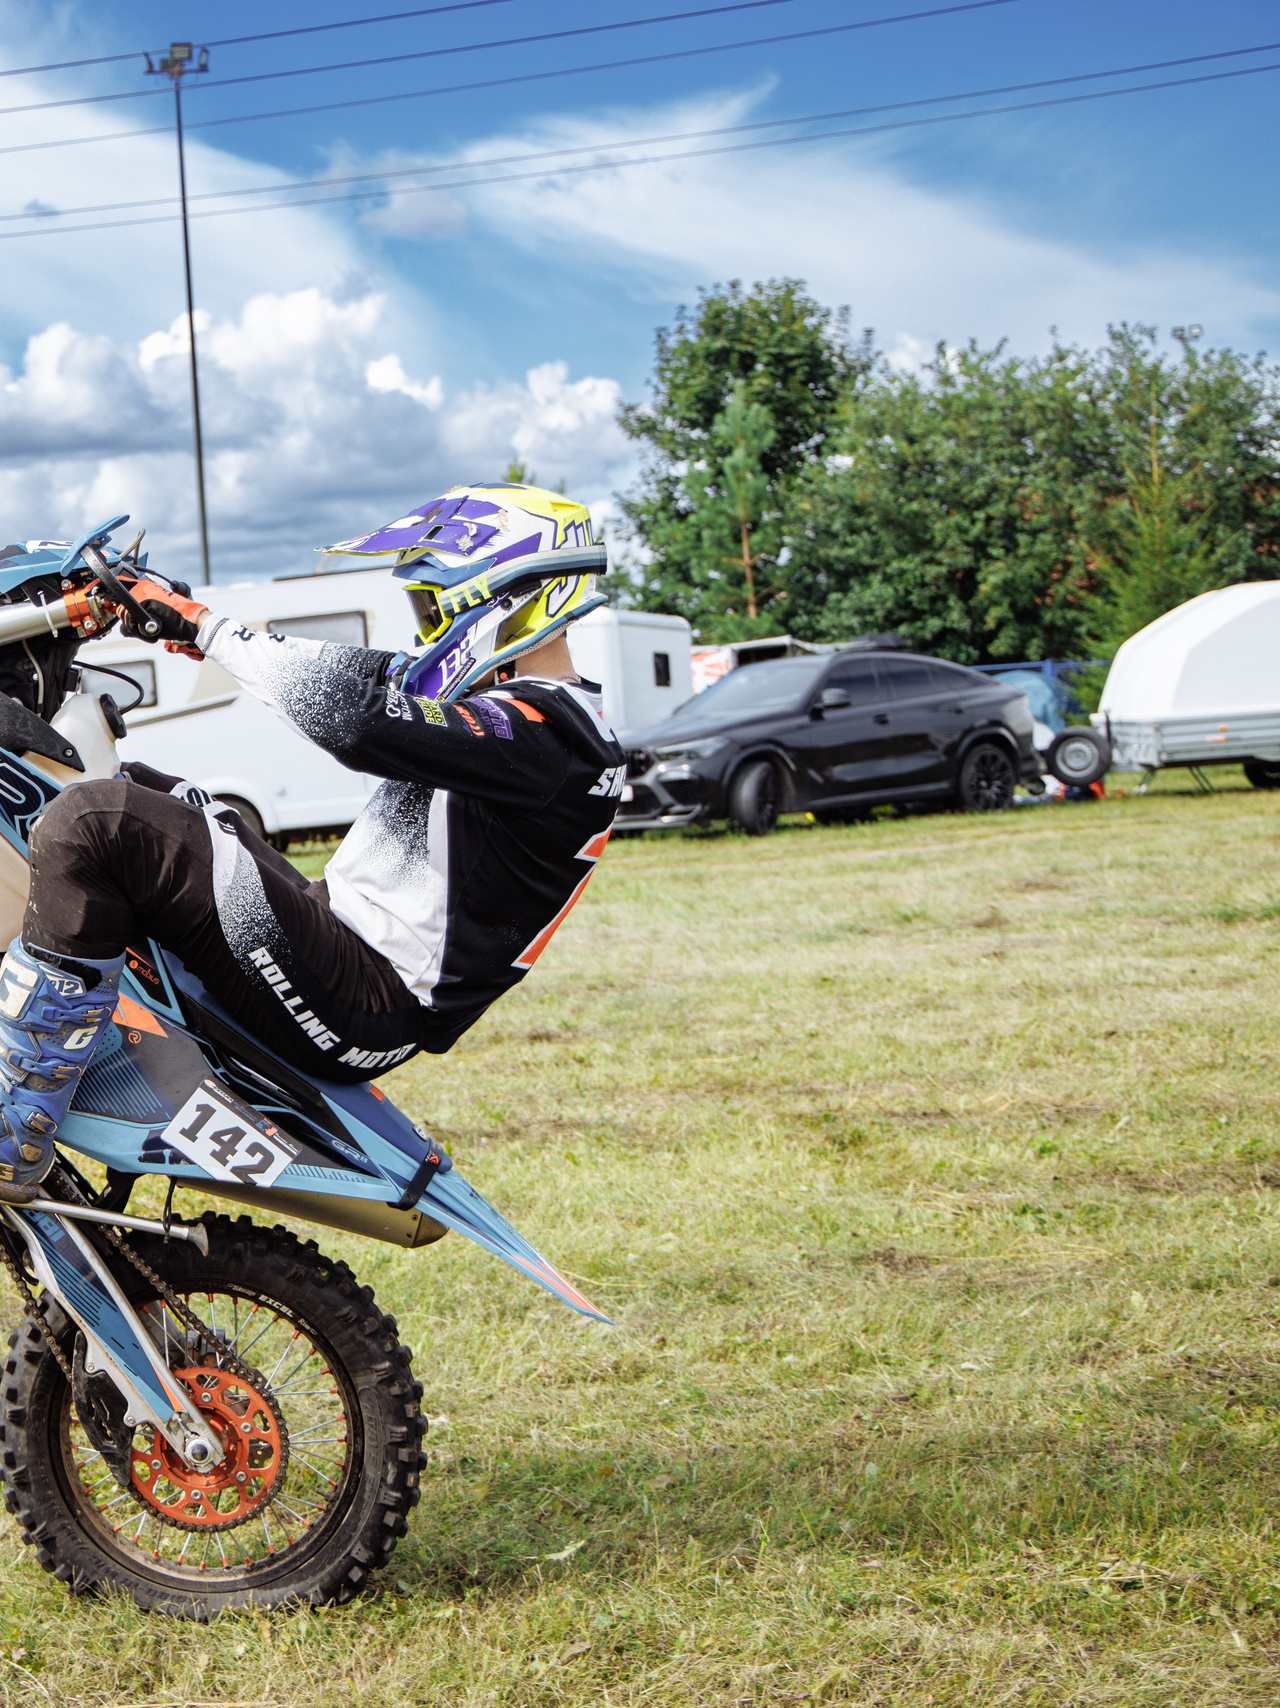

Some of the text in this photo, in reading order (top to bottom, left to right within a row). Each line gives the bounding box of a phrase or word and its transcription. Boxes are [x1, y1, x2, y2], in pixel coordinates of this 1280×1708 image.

[447, 574, 493, 613] FLY
[248, 947, 417, 1069] ROLLING MOTO
[179, 1103, 275, 1185] 142
[331, 1139, 368, 1163] GR8
[258, 1293, 295, 1318] EXCEL
